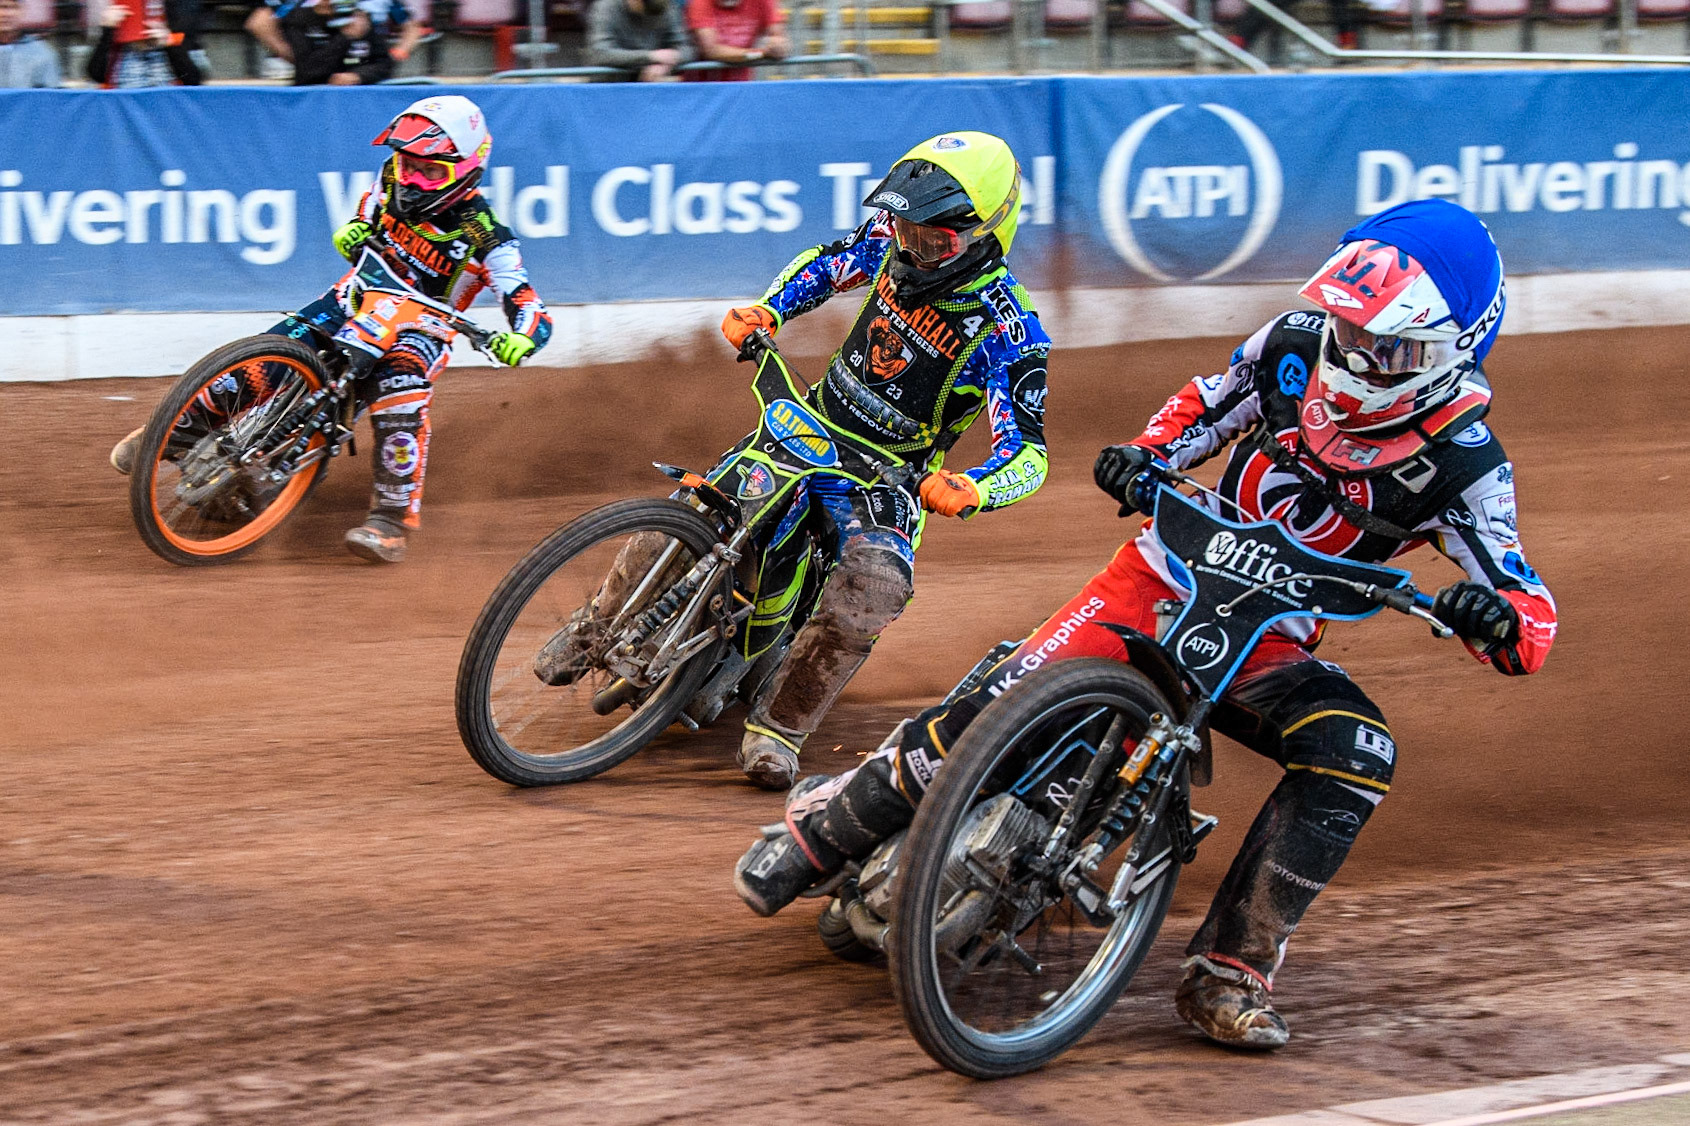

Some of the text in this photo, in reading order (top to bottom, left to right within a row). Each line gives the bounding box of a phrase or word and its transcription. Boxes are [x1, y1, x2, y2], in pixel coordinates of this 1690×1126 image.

[318, 165, 570, 238] Wld
[592, 163, 803, 237] Class
[876, 192, 907, 209] SHOEI
[1130, 166, 1250, 220] ATPI
[449, 239, 470, 261] 3
[889, 312, 908, 331] FEN
[907, 328, 940, 359] TIGERS
[962, 315, 984, 338] 4
[849, 350, 902, 400] 20 23
[848, 404, 905, 440] RECOVERY
[1022, 460, 1037, 479] &
[1184, 636, 1220, 658] ATPI
